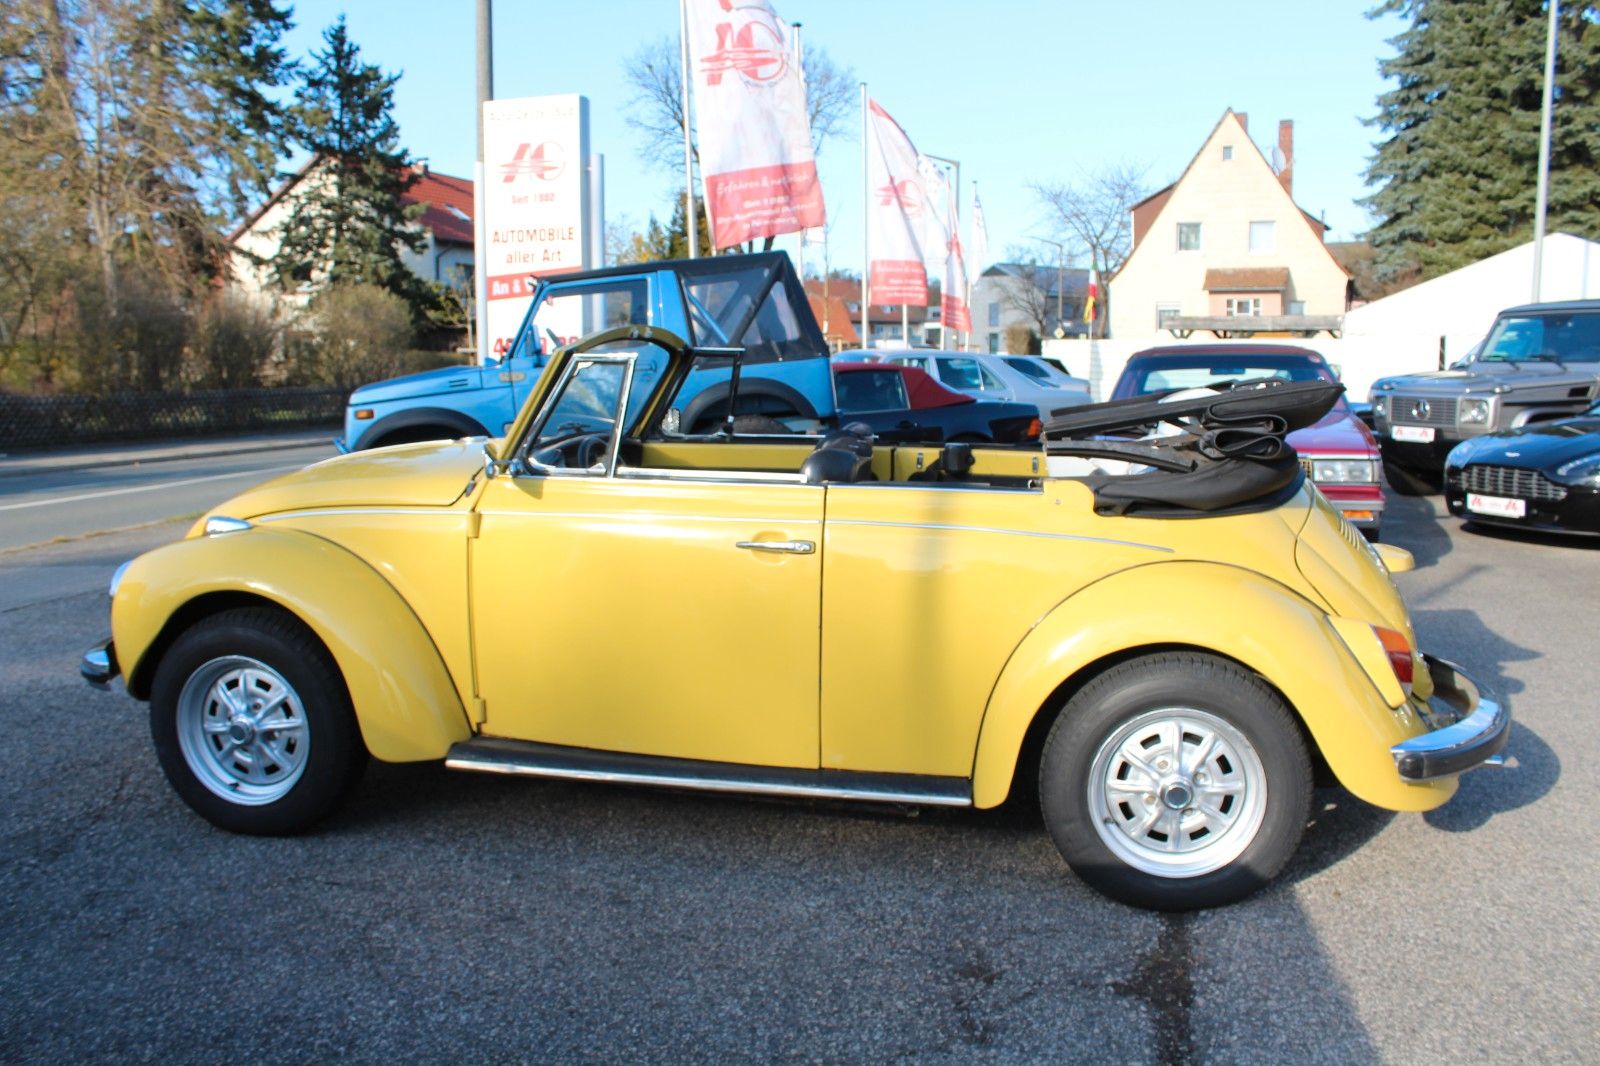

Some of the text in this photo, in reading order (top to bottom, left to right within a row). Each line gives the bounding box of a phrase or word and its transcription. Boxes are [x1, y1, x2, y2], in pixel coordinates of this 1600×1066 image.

[493, 226, 574, 243] AUTOMOBILE
[506, 249, 561, 264] aller Art
[492, 280, 509, 296] An
[512, 278, 521, 293] &
